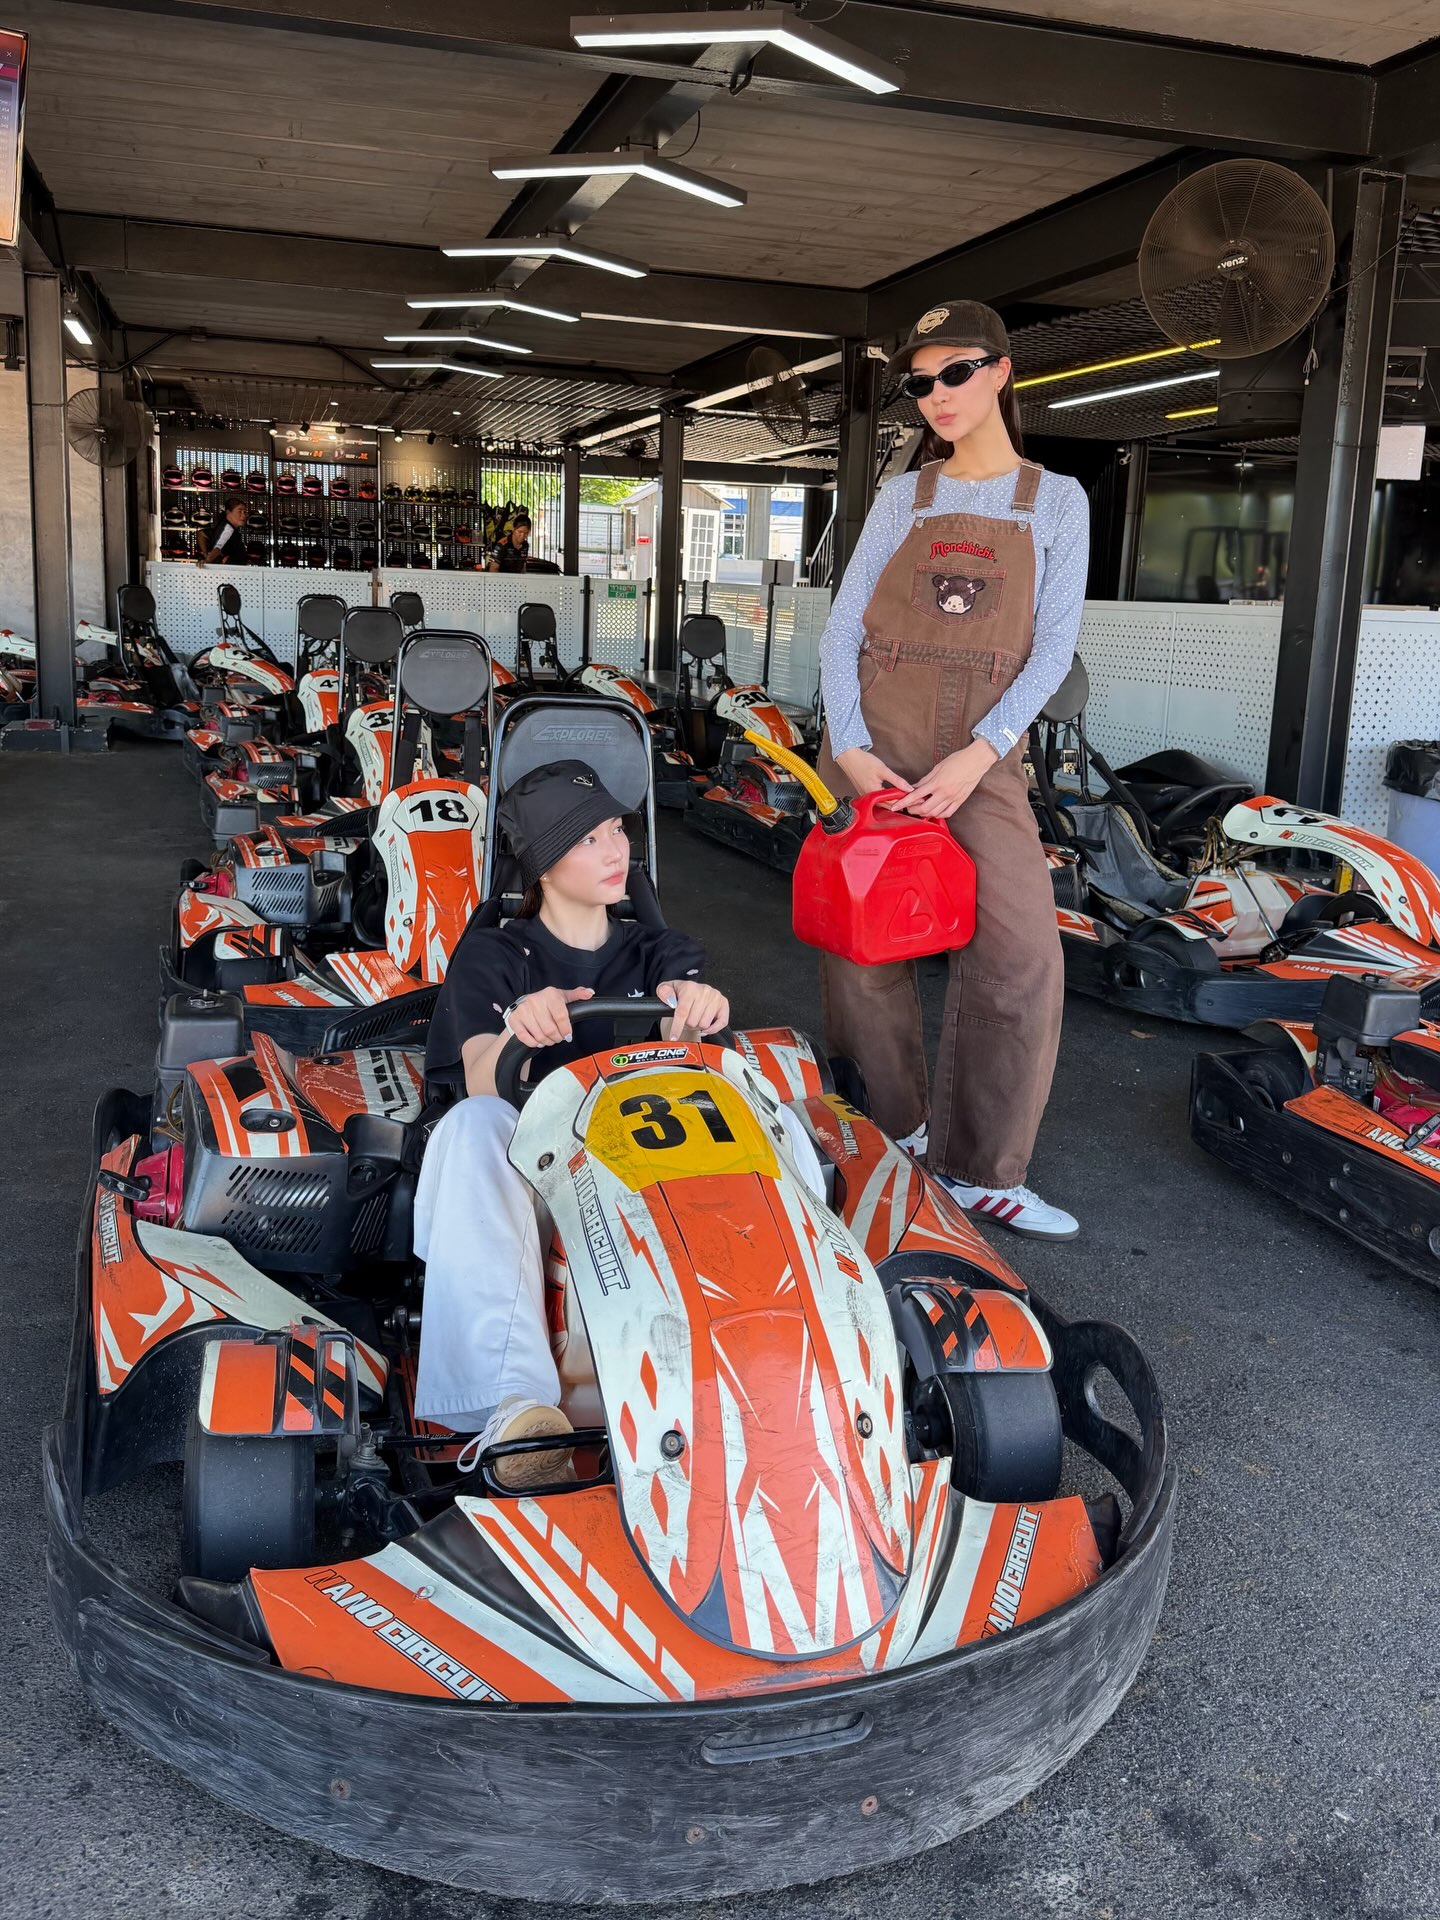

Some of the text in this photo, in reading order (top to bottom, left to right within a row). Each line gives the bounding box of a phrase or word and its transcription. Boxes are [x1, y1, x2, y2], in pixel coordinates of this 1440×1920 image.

[930, 540, 995, 560] Monchhichi
[735, 691, 773, 708] 30
[530, 723, 618, 744] EXPLORER
[409, 799, 469, 823] 18
[627, 1051, 656, 1061] TOP
[619, 1090, 736, 1150] 31
